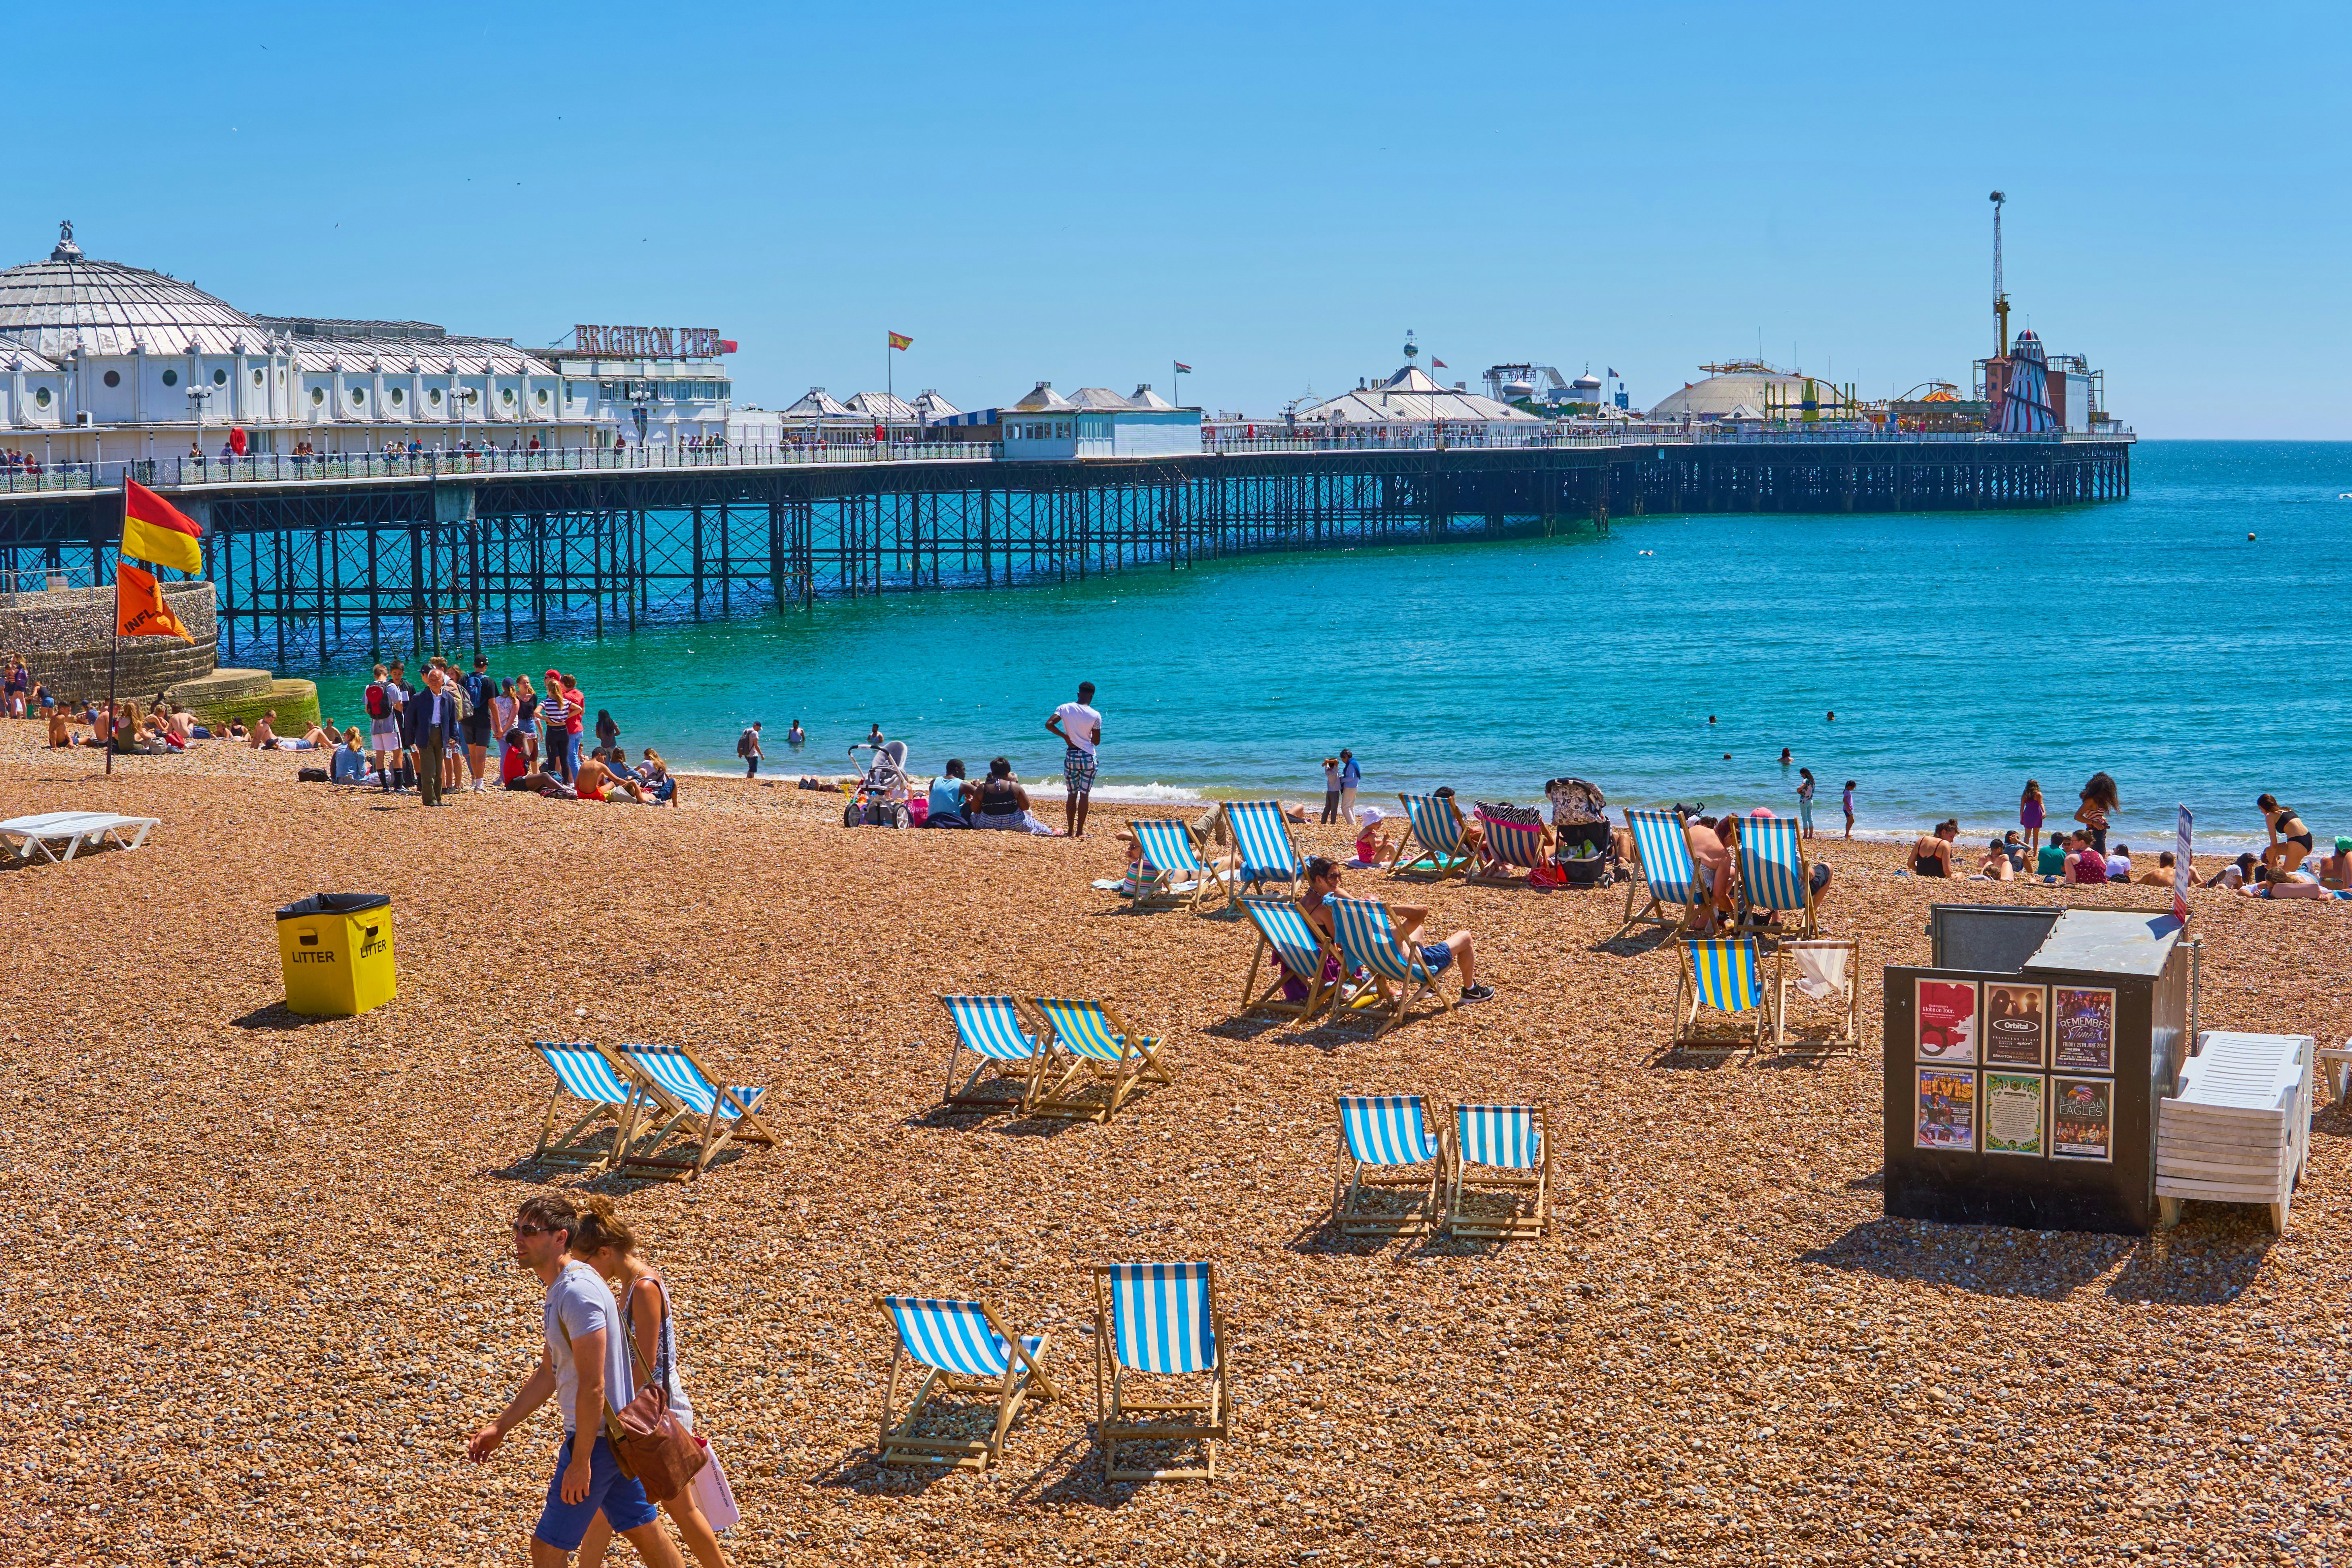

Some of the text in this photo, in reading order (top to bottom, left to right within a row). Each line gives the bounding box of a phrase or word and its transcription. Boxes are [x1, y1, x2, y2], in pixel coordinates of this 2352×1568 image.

[574, 324, 722, 357] BRIGHTON PIER
[1509, 370, 1536, 379] RIVER
[360, 939, 387, 958] LITTER
[292, 951, 335, 963] LITTER
[2060, 1017, 2110, 1032] REMEMBER
[2071, 1025, 2097, 1040] Times
[1921, 1080, 1972, 1098] ELVIS
[2060, 1099, 2103, 1108] ILLEGAL
[2060, 1105, 2103, 1116] EAGLES
